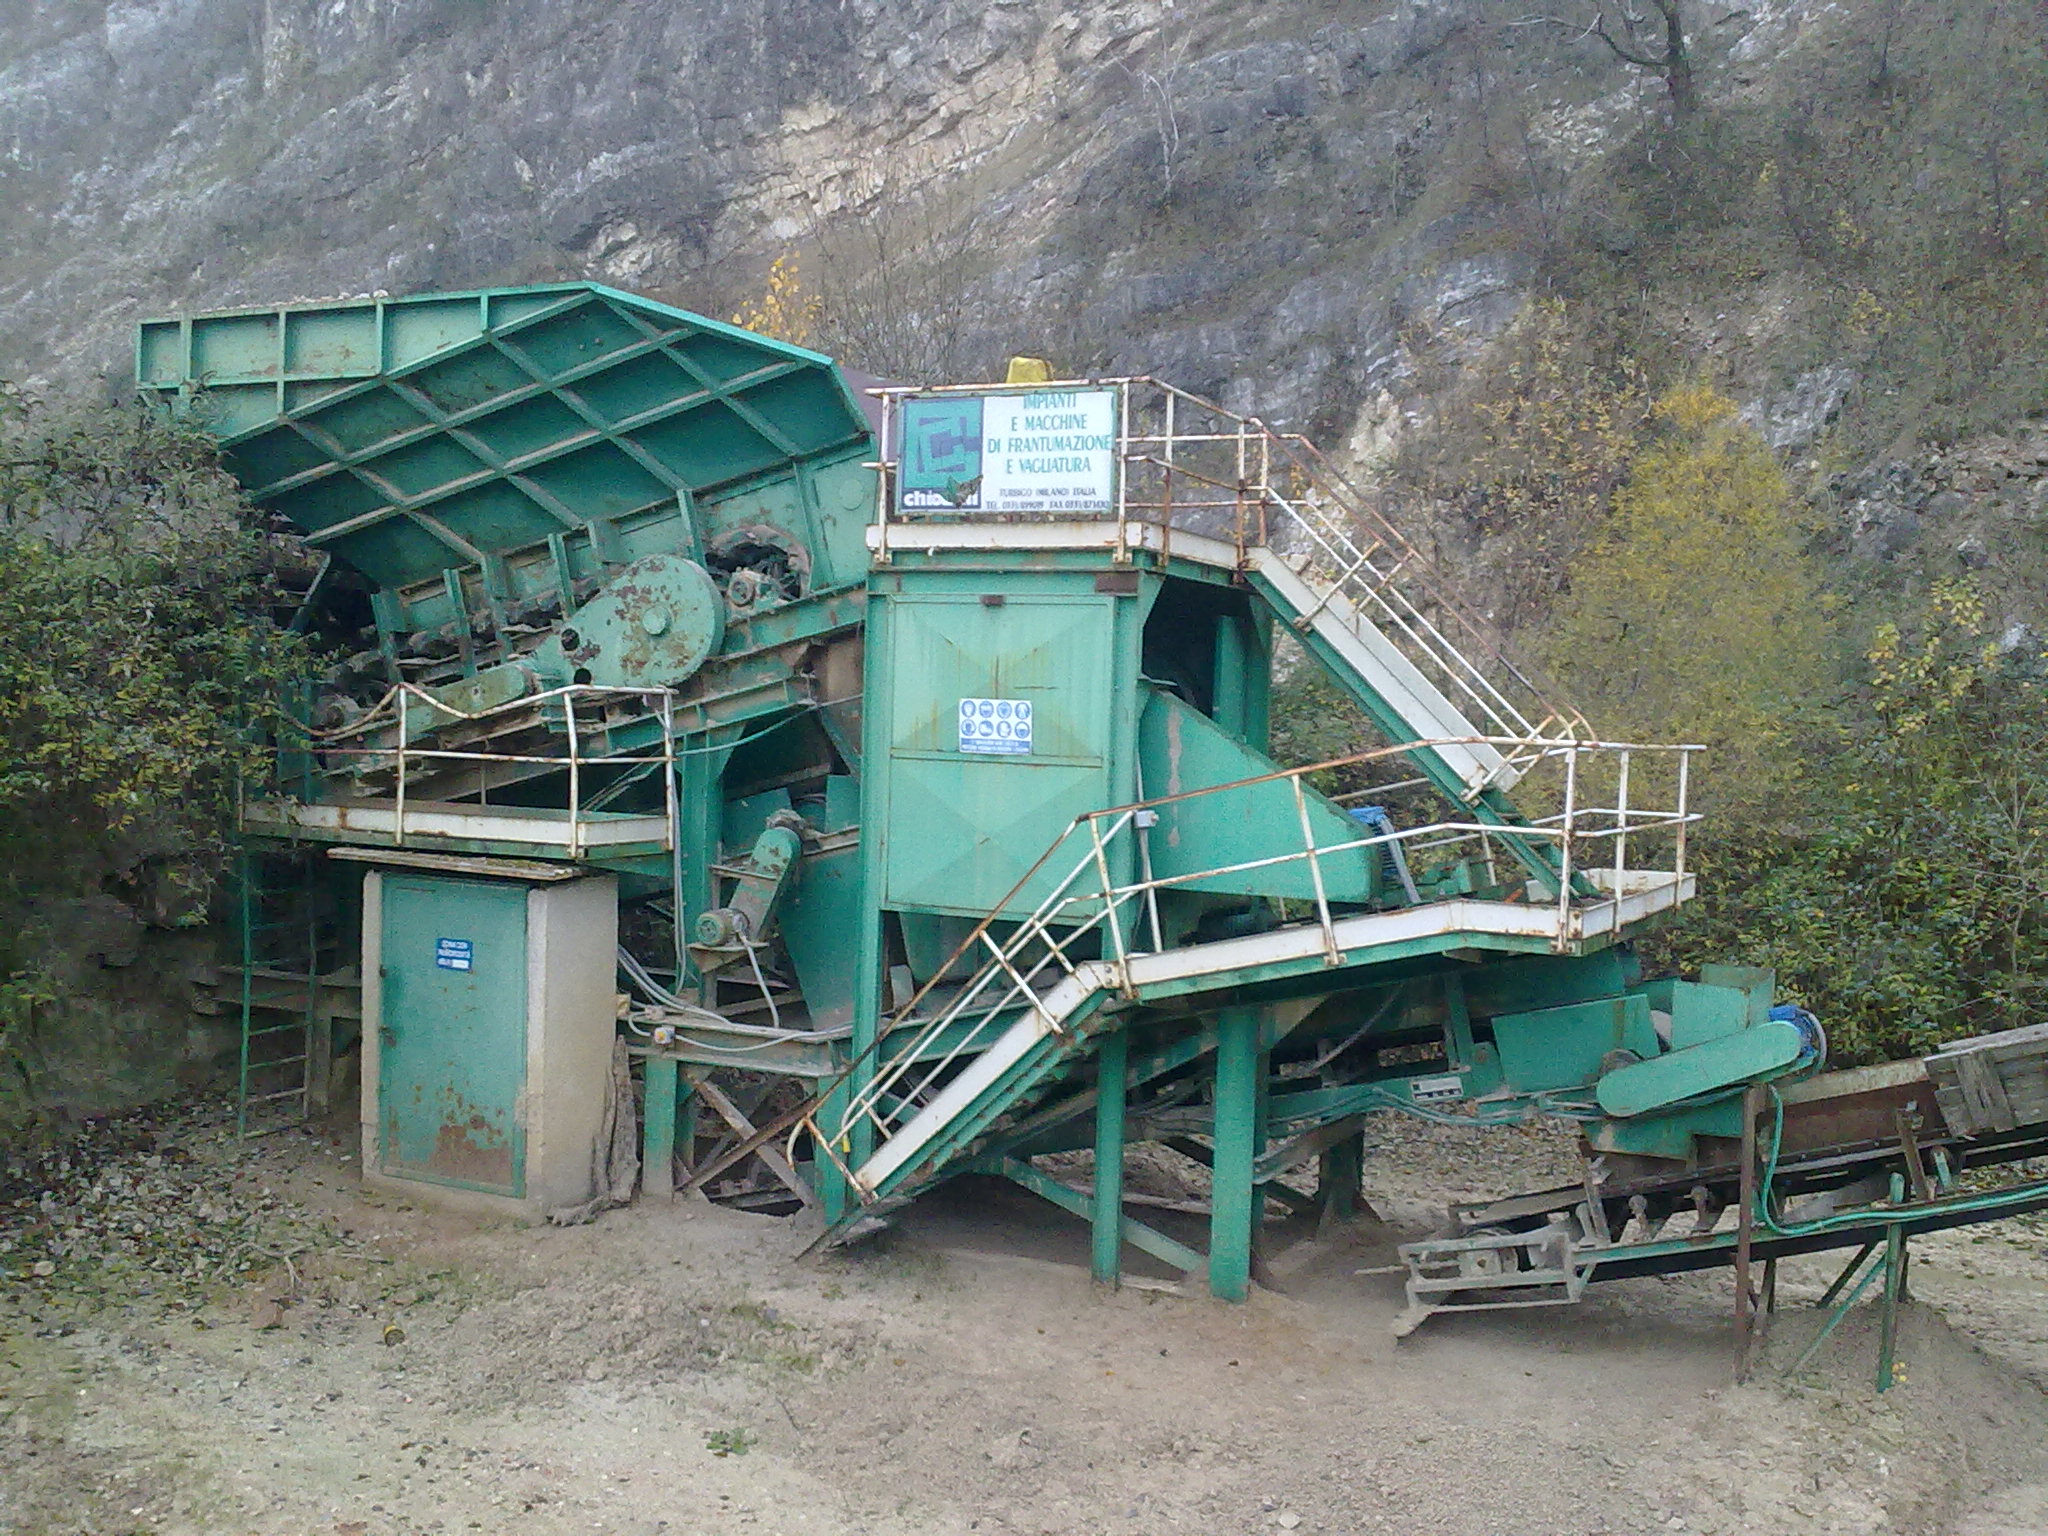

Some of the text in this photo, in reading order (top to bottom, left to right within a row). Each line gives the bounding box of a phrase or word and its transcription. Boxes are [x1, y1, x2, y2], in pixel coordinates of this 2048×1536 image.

[1023, 392, 1077, 409] IMPIANTI
[1011, 413, 1088, 432] E MACCHINE
[987, 434, 1111, 453] DI FRANTUMAZIONE
[1006, 456, 1092, 474] E VAGLIATURA
[1073, 487, 1097, 496] ITALIA
